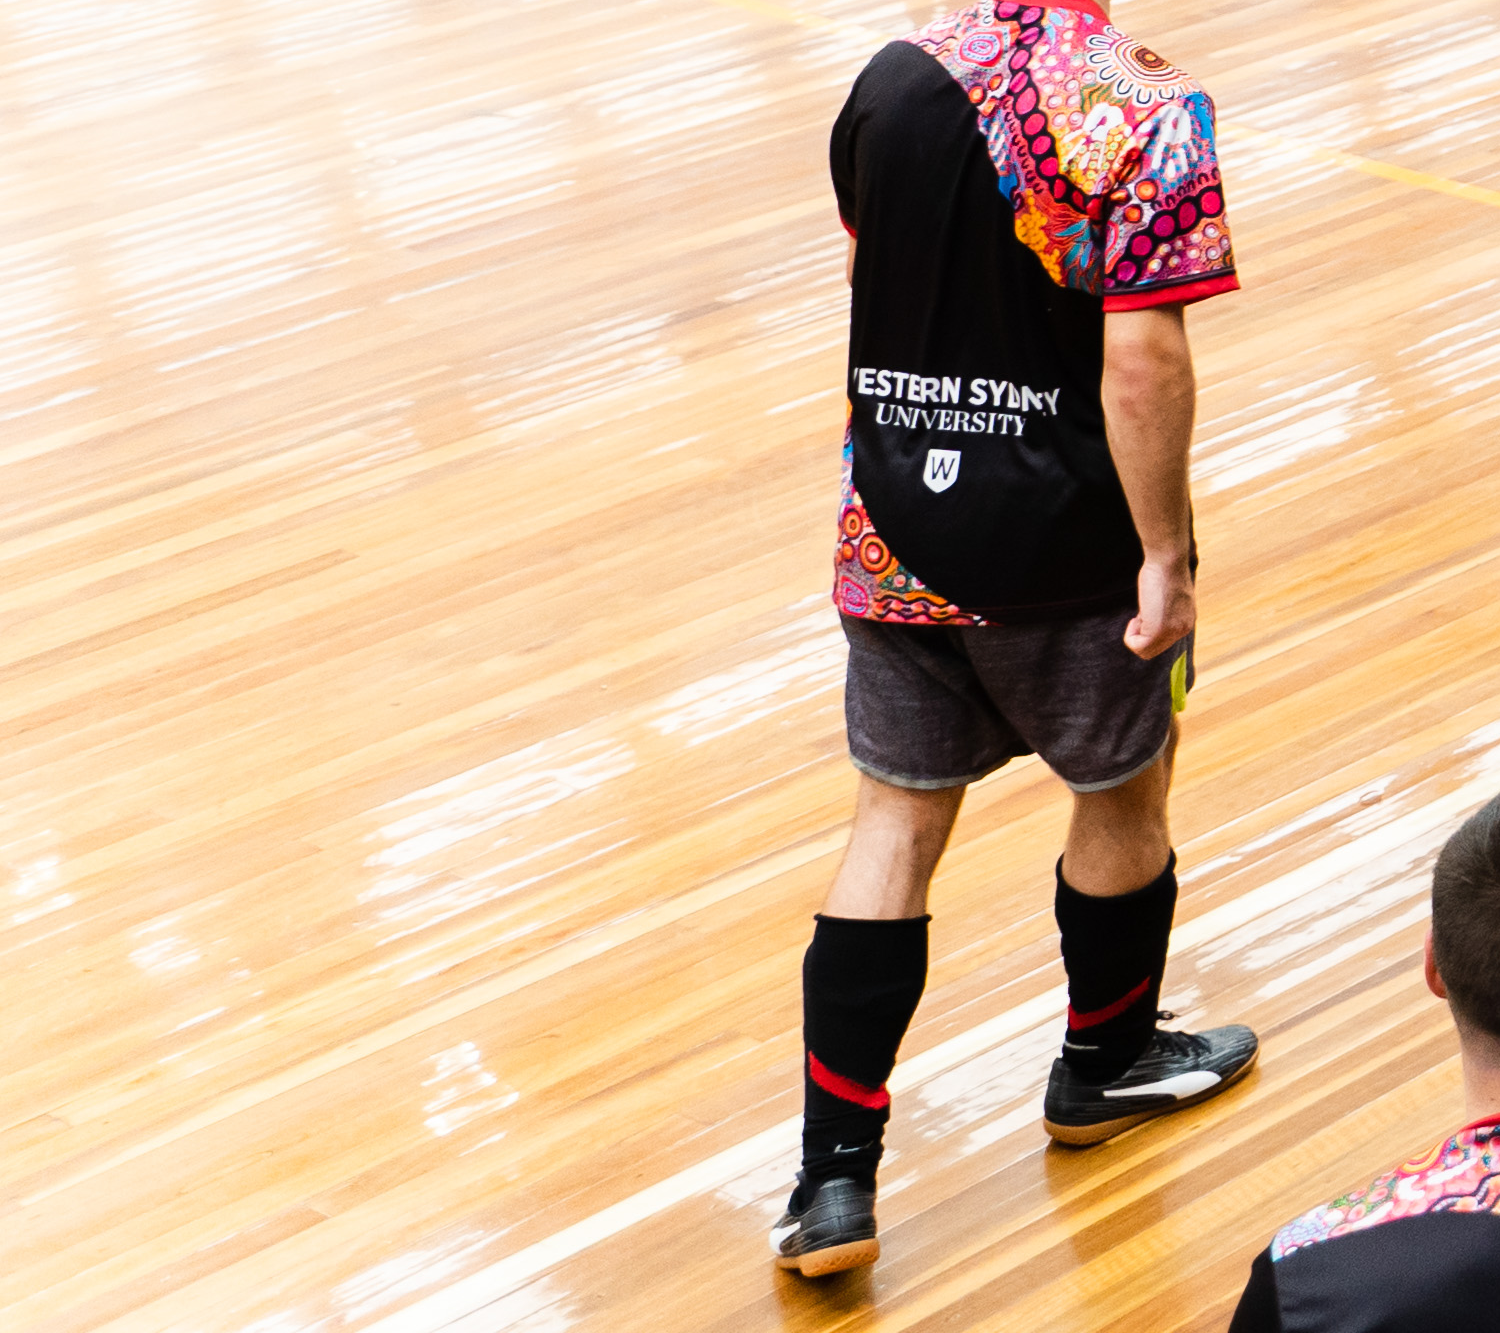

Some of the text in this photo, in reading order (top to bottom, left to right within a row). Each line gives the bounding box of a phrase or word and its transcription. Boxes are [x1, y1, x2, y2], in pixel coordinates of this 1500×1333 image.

[853, 367, 961, 405] ESTERN
[875, 402, 1027, 438] UNIVERSITY
[930, 456, 957, 481] W
